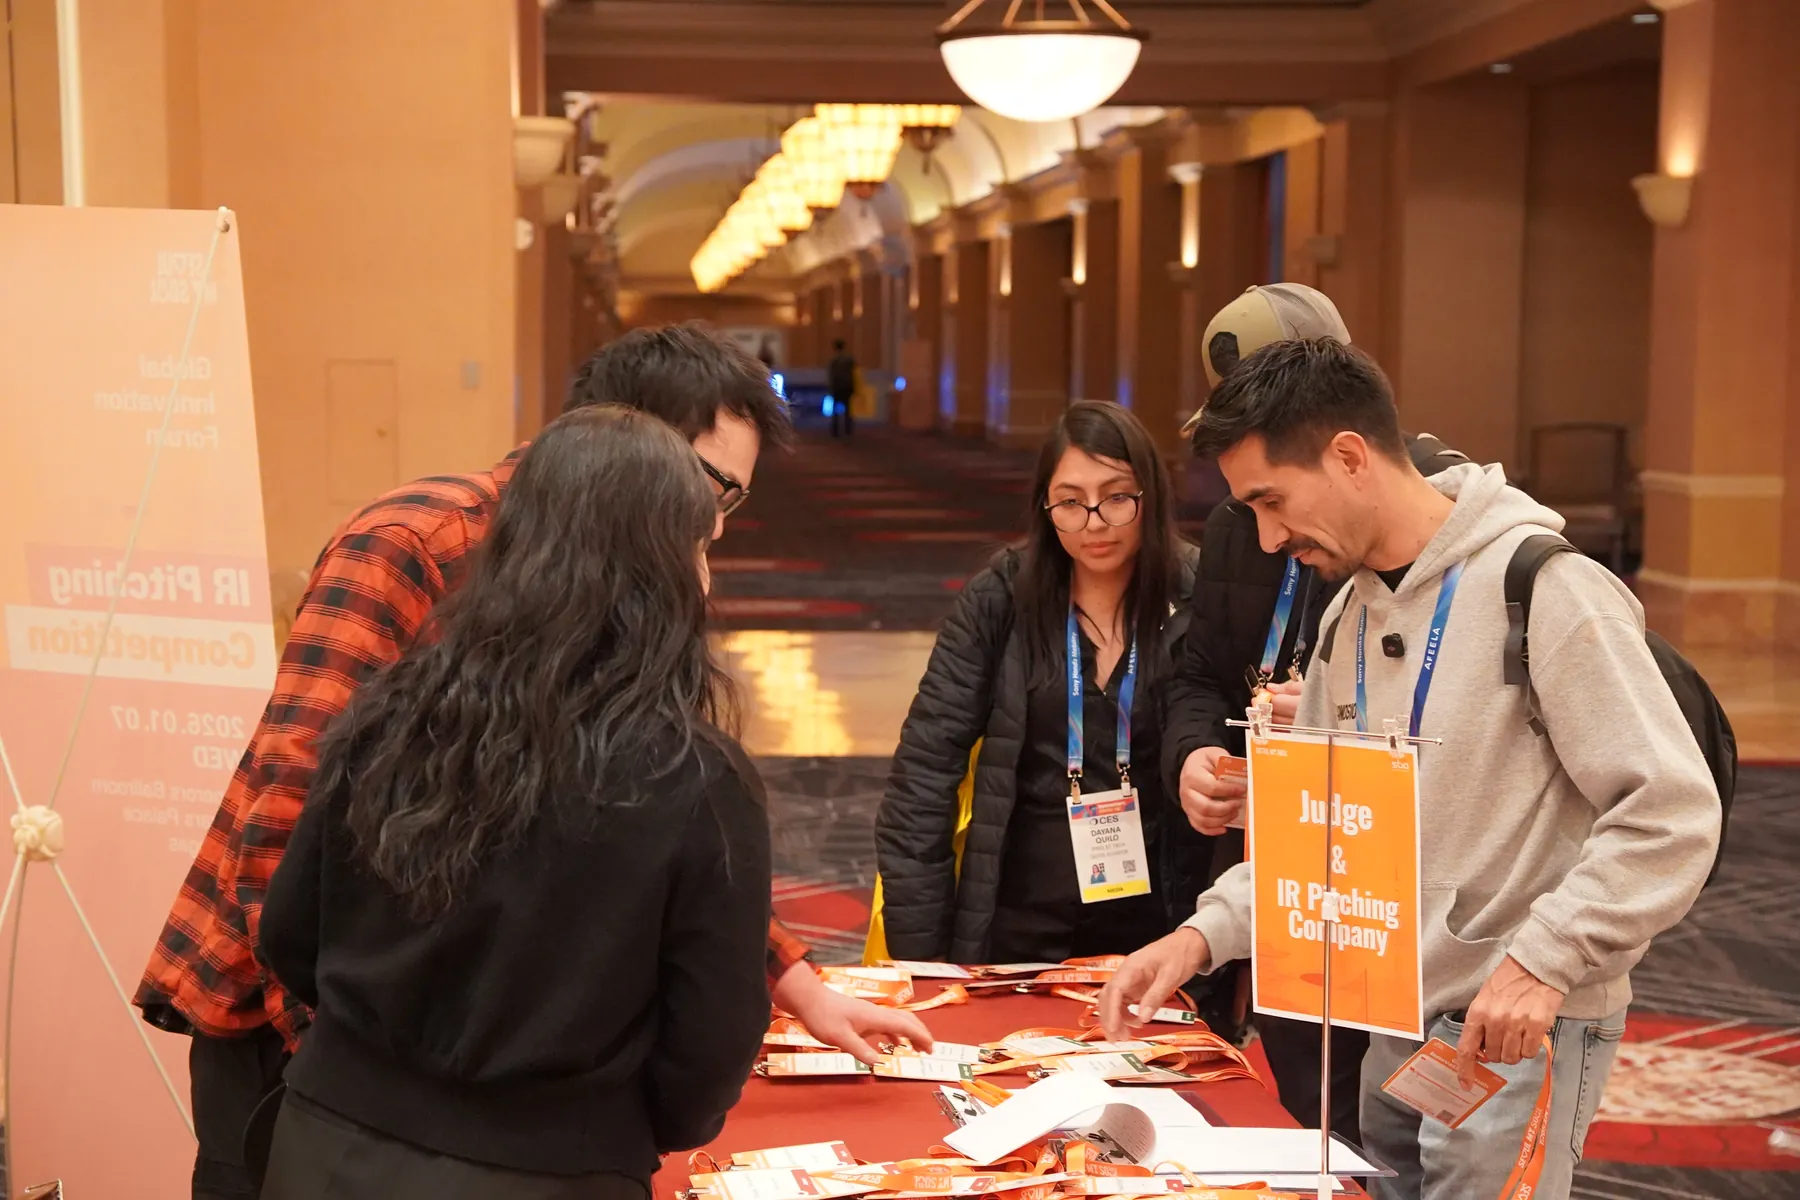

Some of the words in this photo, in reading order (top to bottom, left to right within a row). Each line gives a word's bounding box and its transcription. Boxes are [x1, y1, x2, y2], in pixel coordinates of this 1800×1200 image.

[1284, 577, 1296, 596] Sony
[1424, 627, 1441, 670] AFEELA
[1071, 658, 1079, 679] Honda
[1072, 679, 1080, 697] Sony
[1099, 815, 1119, 825] CES
[1299, 789, 1373, 836] Judge
[1331, 845, 1347, 875] &
[1277, 878, 1301, 909] IR
